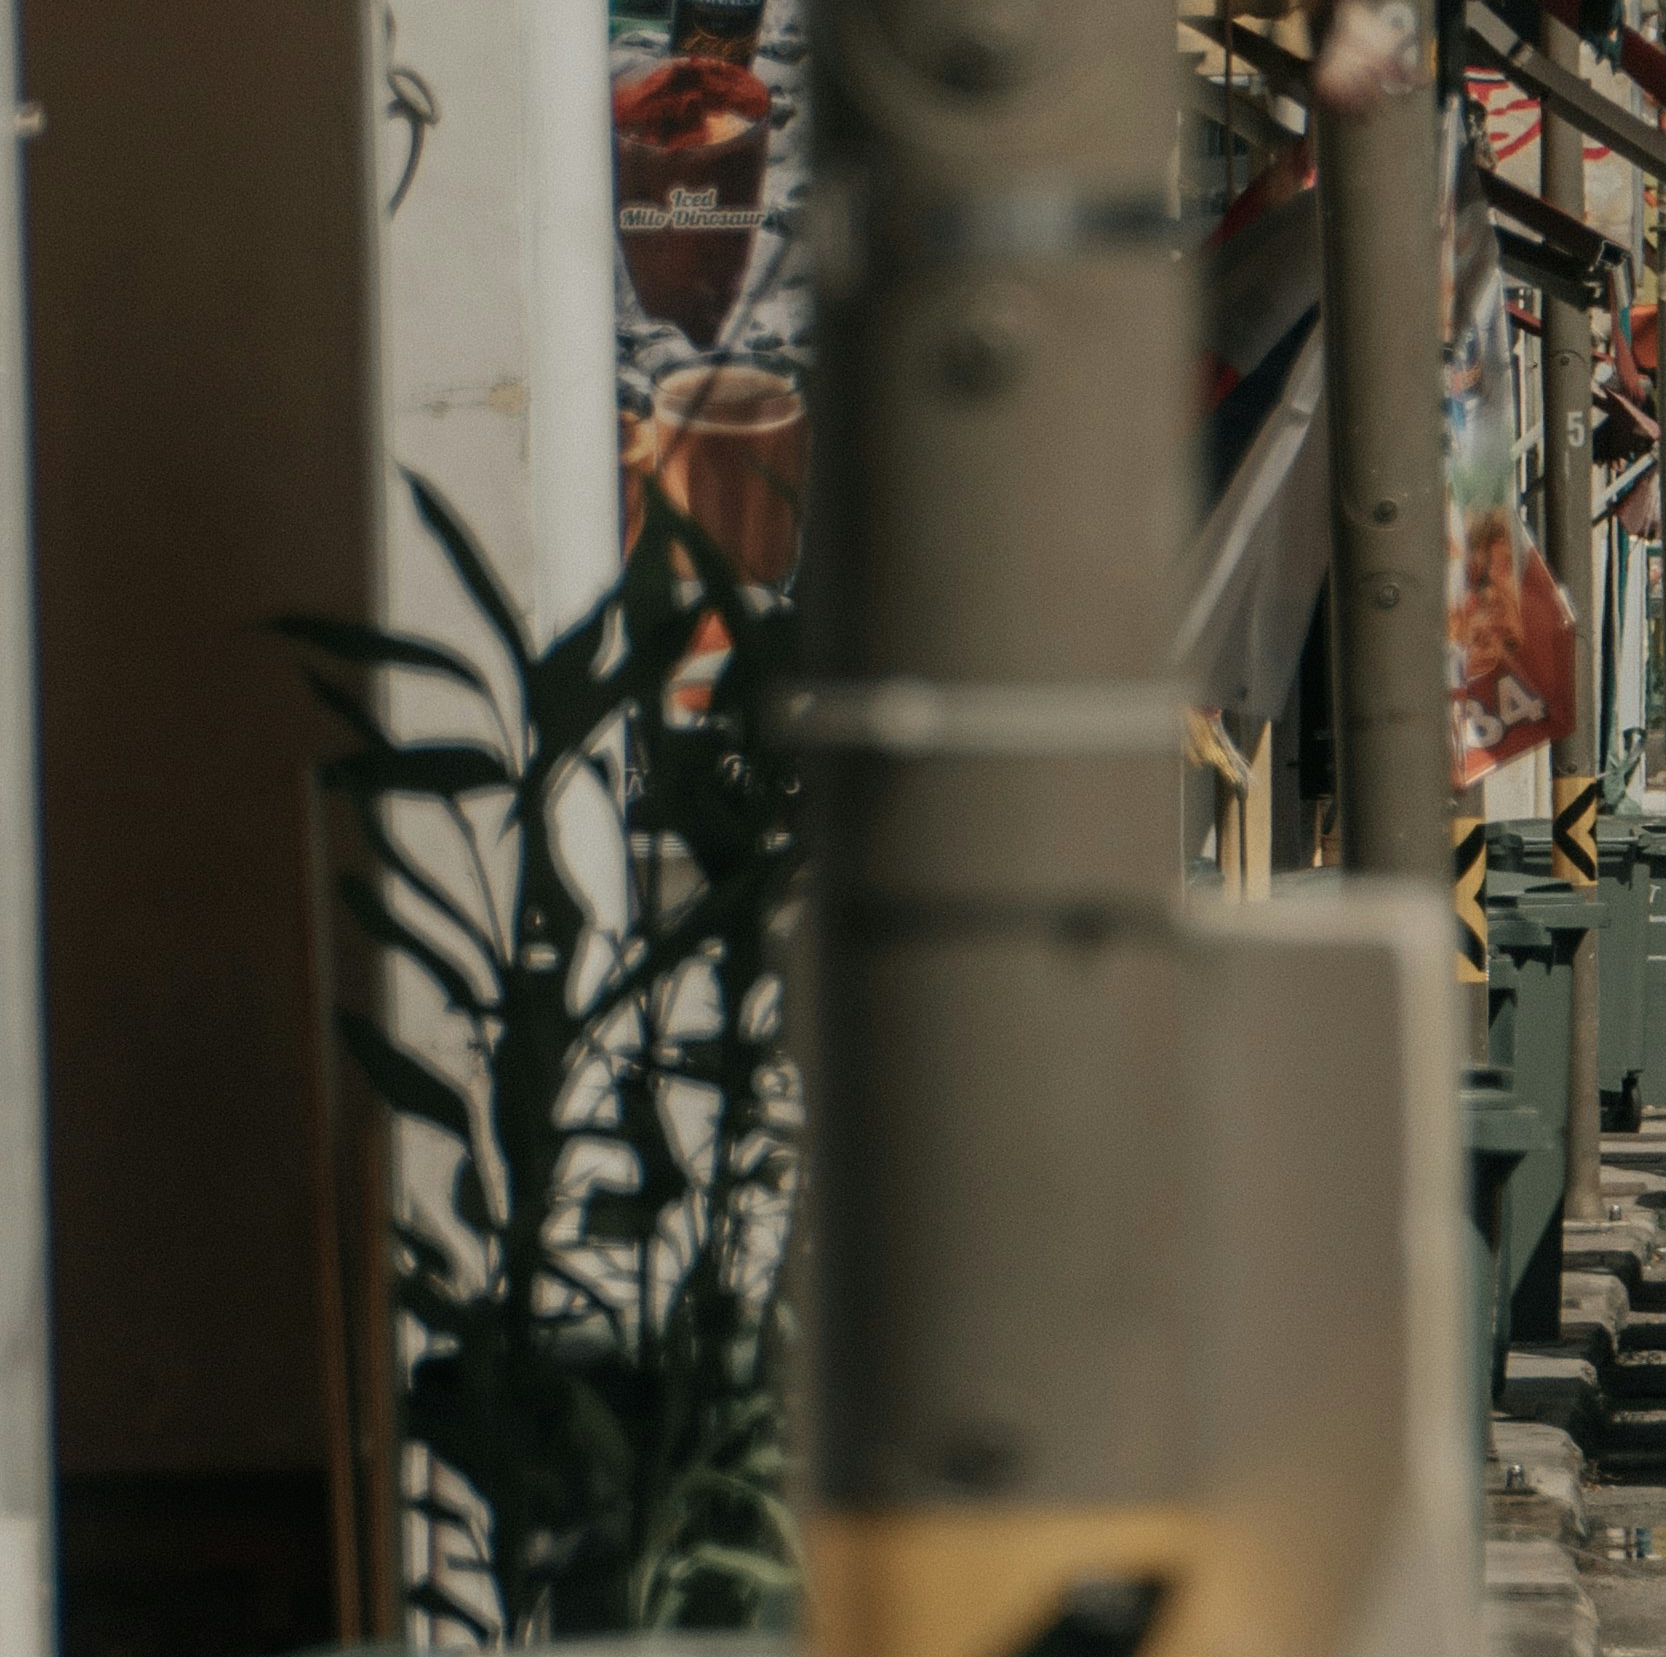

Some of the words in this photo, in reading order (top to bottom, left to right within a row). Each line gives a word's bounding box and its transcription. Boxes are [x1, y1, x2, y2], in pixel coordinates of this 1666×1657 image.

[671, 188, 717, 209] Iced
[621, 208, 668, 229] Milo
[672, 209, 763, 229] Dinosaur
[1566, 410, 1585, 448] 5
